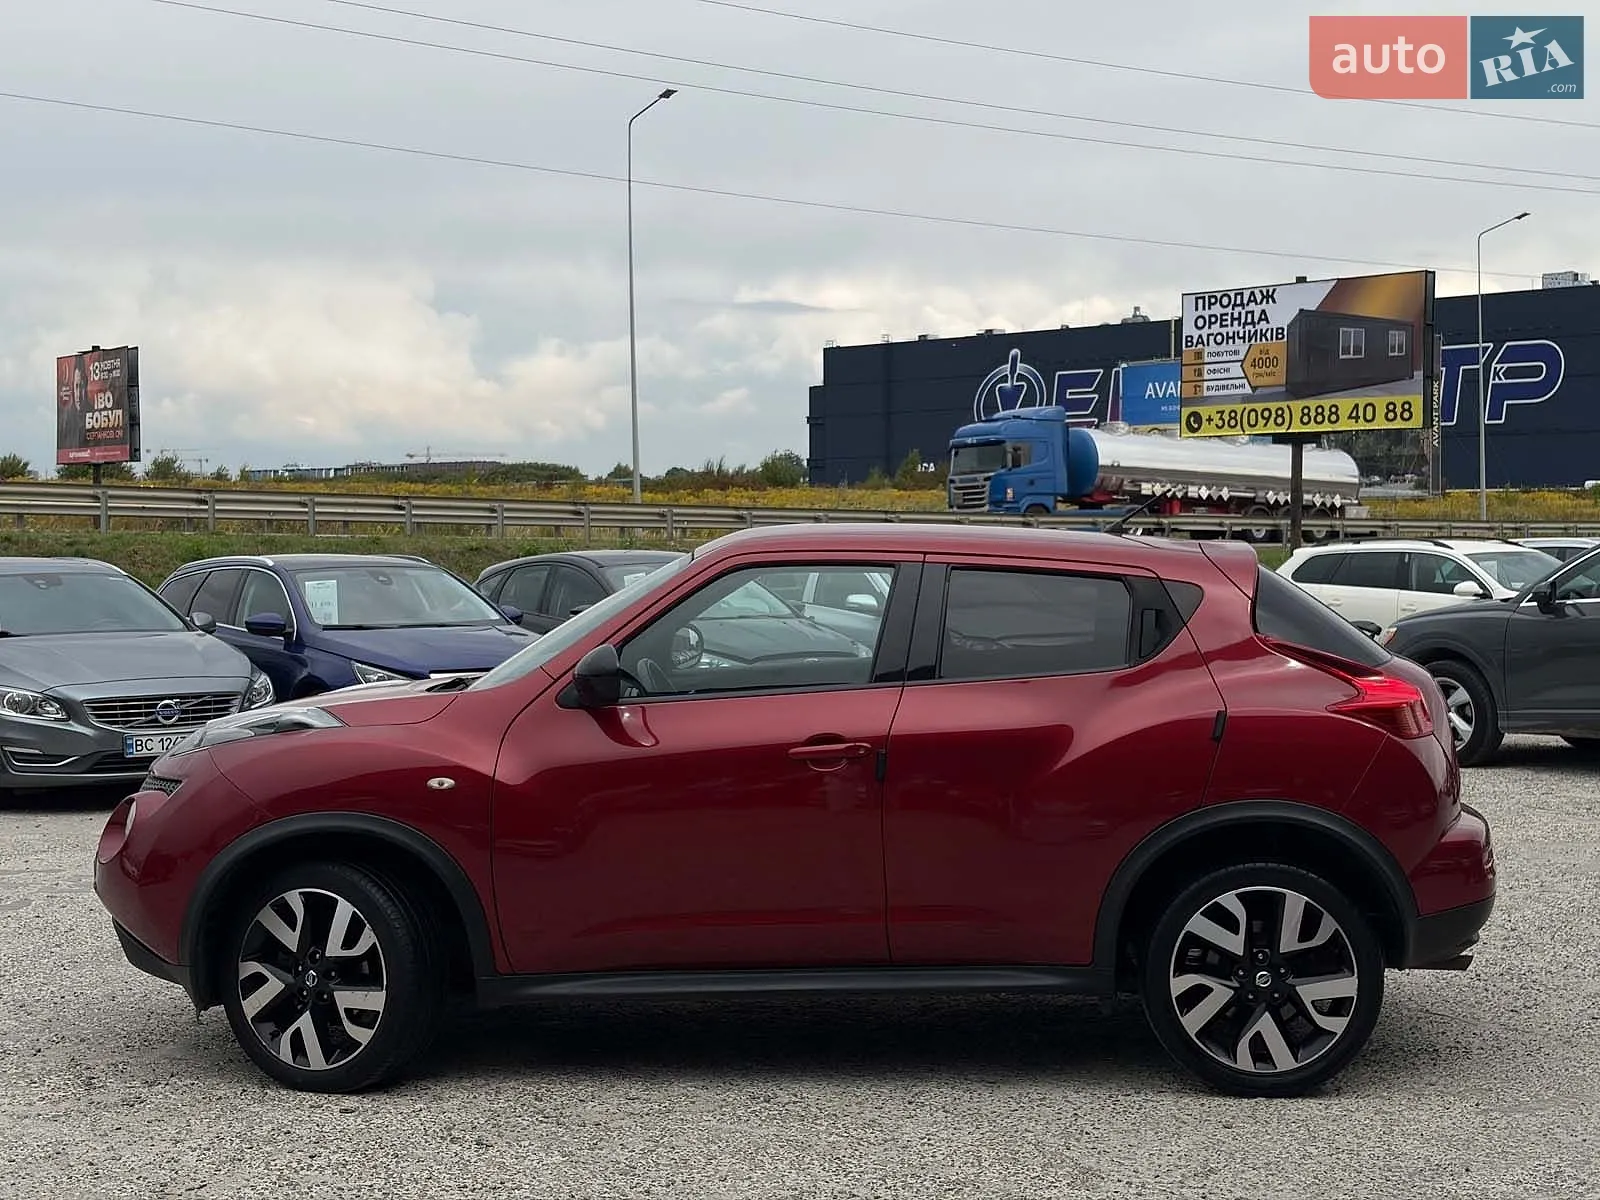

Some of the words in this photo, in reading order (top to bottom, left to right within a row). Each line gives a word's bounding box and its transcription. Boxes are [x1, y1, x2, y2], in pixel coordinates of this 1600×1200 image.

[1194, 288, 1277, 312] ПРОДАЖ
[1194, 309, 1270, 331] ОРЕНДА
[1184, 327, 1286, 348] ВАГОНЧИКІВ
[90, 362, 100, 381] 13
[1250, 356, 1279, 369] 4000
[94, 391, 113, 409] ІВО
[85, 409, 123, 429] БОБУЛ
[1205, 405, 1293, 432] +38(098)
[1300, 404, 1340, 426] 888
[1347, 402, 1377, 423] 40
[1384, 400, 1414, 422] 88
[135, 739, 154, 752] BC
